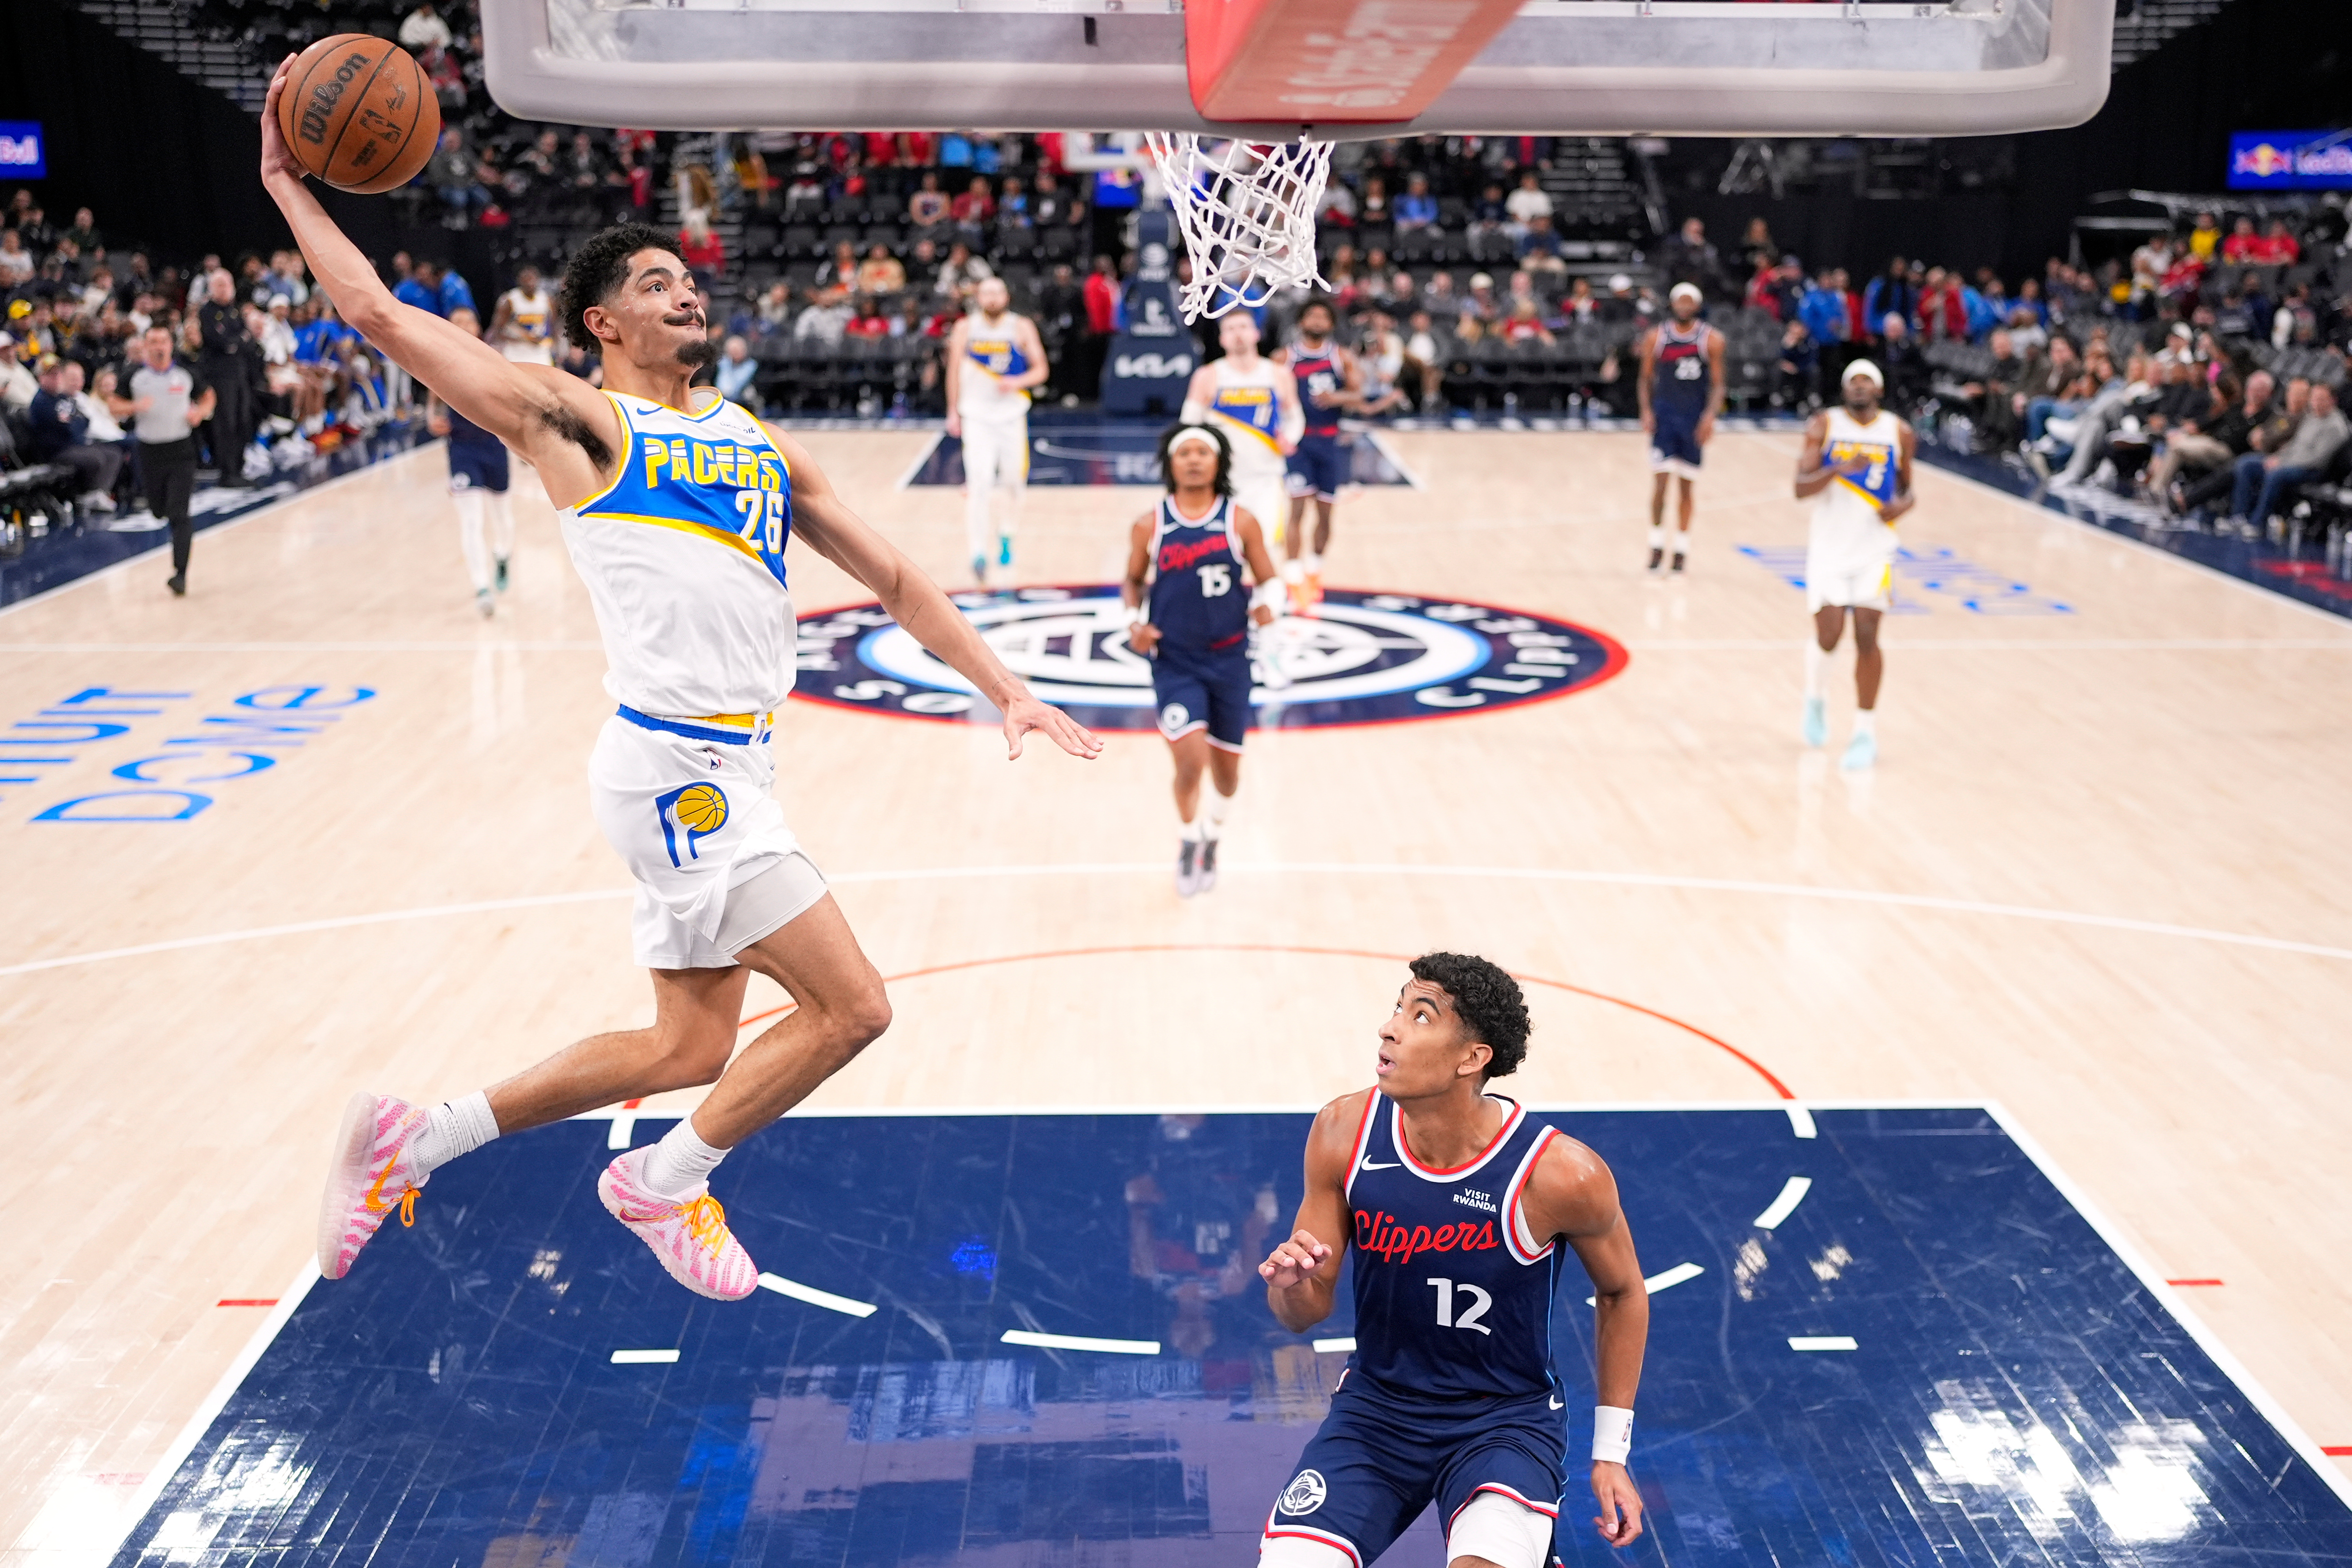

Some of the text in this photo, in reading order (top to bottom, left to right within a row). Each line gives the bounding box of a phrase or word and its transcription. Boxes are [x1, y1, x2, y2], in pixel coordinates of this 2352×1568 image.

[299, 53, 372, 145] Wilson
[644, 437, 781, 490] PACERS
[735, 489, 784, 554] 26
[1197, 563, 1231, 598] 15
[1453, 1194, 1497, 1213] RWANDA
[1464, 1188, 1490, 1202] VISIT
[1354, 1210, 1499, 1264] Clippers
[1426, 1278, 1492, 1336] 12
